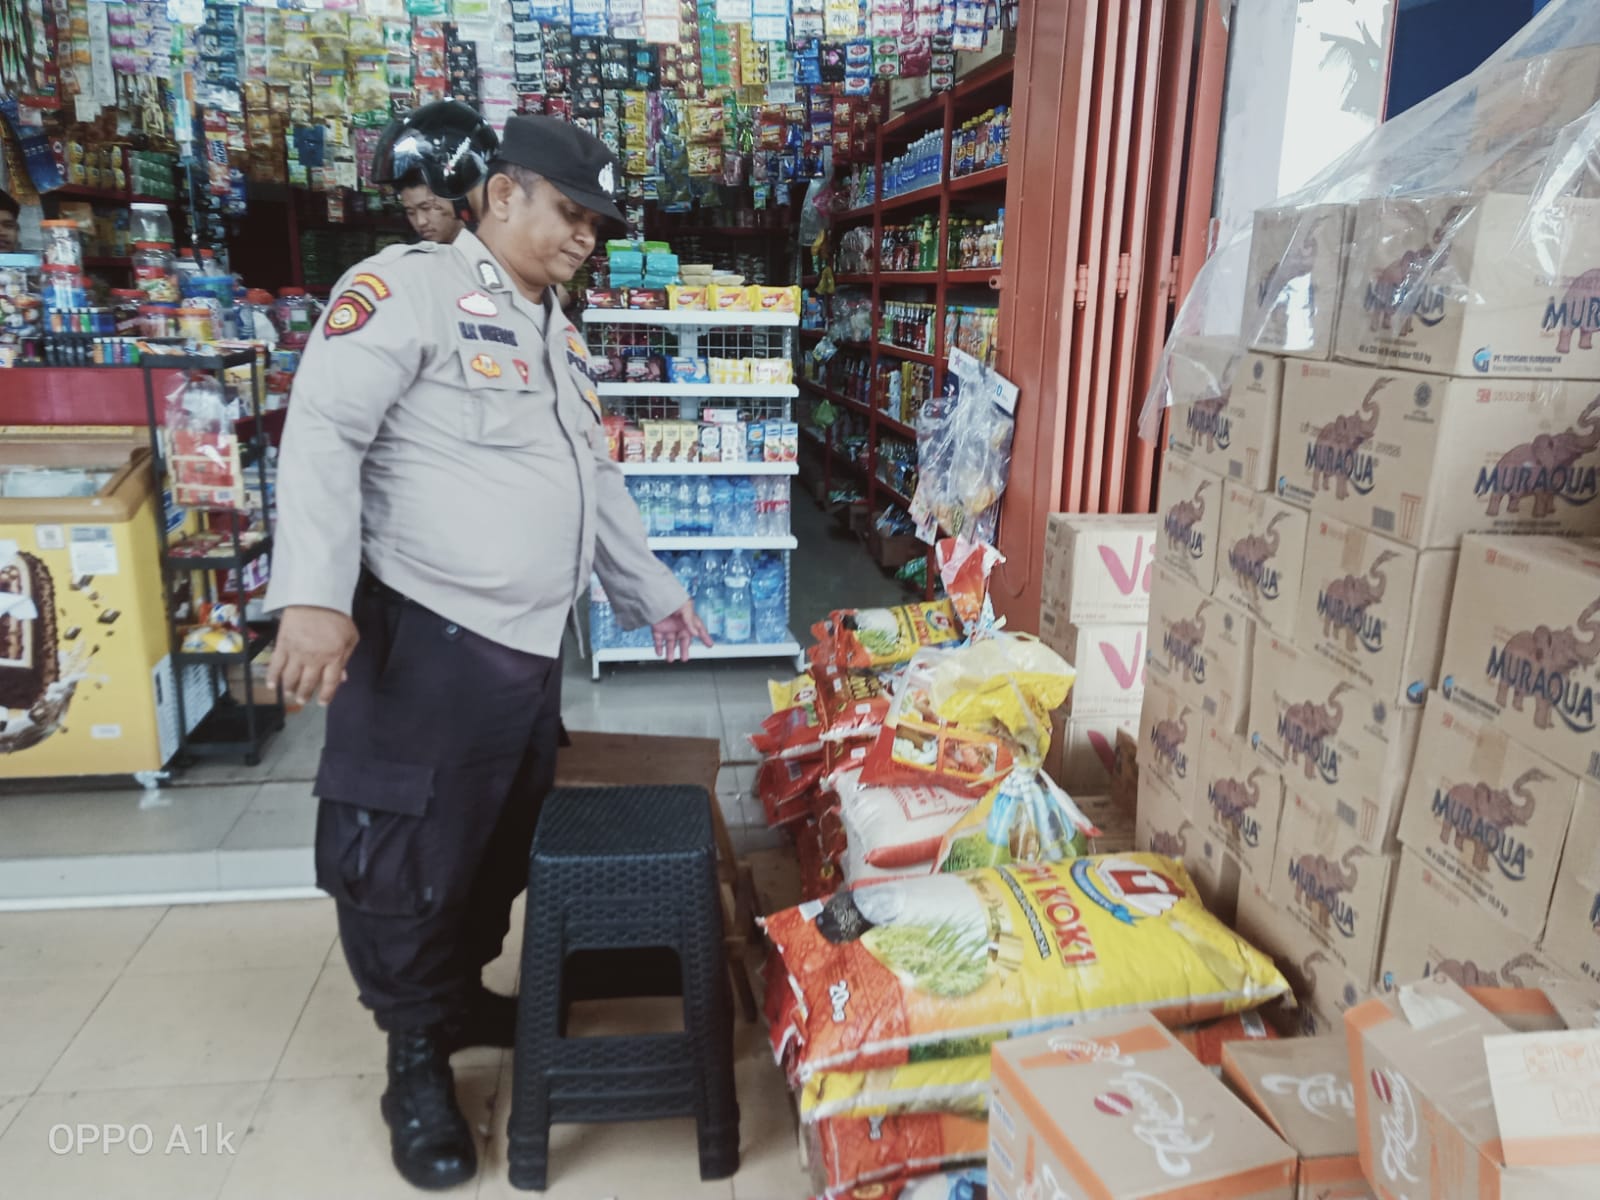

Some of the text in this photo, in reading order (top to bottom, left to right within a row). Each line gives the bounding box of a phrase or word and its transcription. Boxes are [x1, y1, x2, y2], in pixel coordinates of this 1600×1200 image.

[1304, 441, 1375, 496] MURAQUA
[1474, 466, 1598, 506] MURAQUA
[1317, 589, 1383, 653] MURAQUA
[1486, 645, 1597, 733] MURAQUA
[1277, 711, 1339, 784] MURAQUA
[1431, 788, 1527, 881] MURAQUA
[1034, 886, 1096, 967] KOKI
[1288, 857, 1356, 938] MURAQUA
